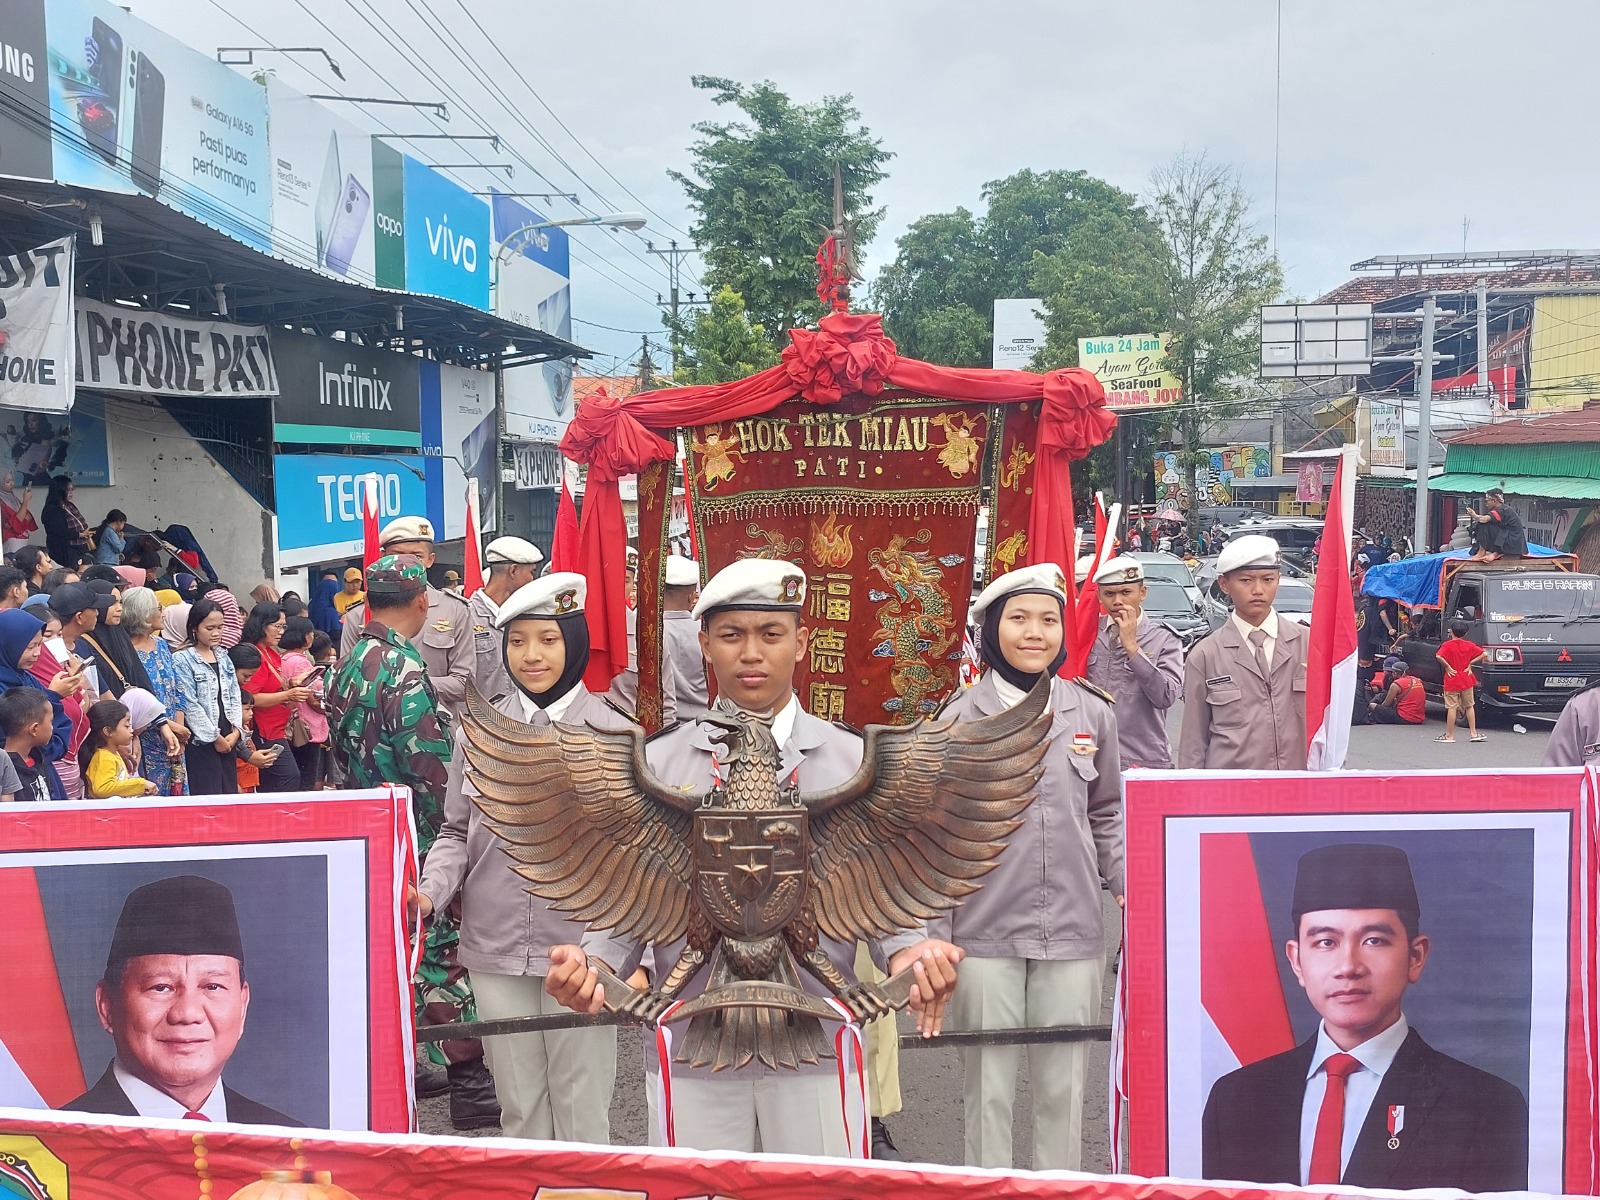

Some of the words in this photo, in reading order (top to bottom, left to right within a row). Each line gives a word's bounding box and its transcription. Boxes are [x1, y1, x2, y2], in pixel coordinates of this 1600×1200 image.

[0, 41, 35, 83] NG
[206, 103, 232, 130] Galaxy
[232, 116, 243, 132] A16
[244, 122, 254, 136] 5G
[200, 130, 223, 156] Pasti
[225, 144, 248, 166] puas
[192, 156, 256, 196] performanya
[376, 212, 402, 237] oppo
[425, 213, 477, 273] vivo
[86, 310, 205, 392] PHONE
[210, 331, 276, 392] PATI
[998, 344, 1024, 352] Reno12
[1085, 340, 1114, 354] Buka
[1118, 339, 1132, 353] 24
[1136, 338, 1160, 352] Jam
[1093, 359, 1131, 377] Ayam
[319, 361, 393, 412] Infinix
[1104, 389, 1149, 406] MBANG
[1111, 378, 1161, 390] SeaFood
[528, 422, 536, 434] KJ
[536, 423, 557, 437] PHONE
[735, 415, 792, 454] HOK
[798, 411, 852, 447] TEK
[858, 415, 929, 451] MIAU
[424, 443, 442, 456] vivo
